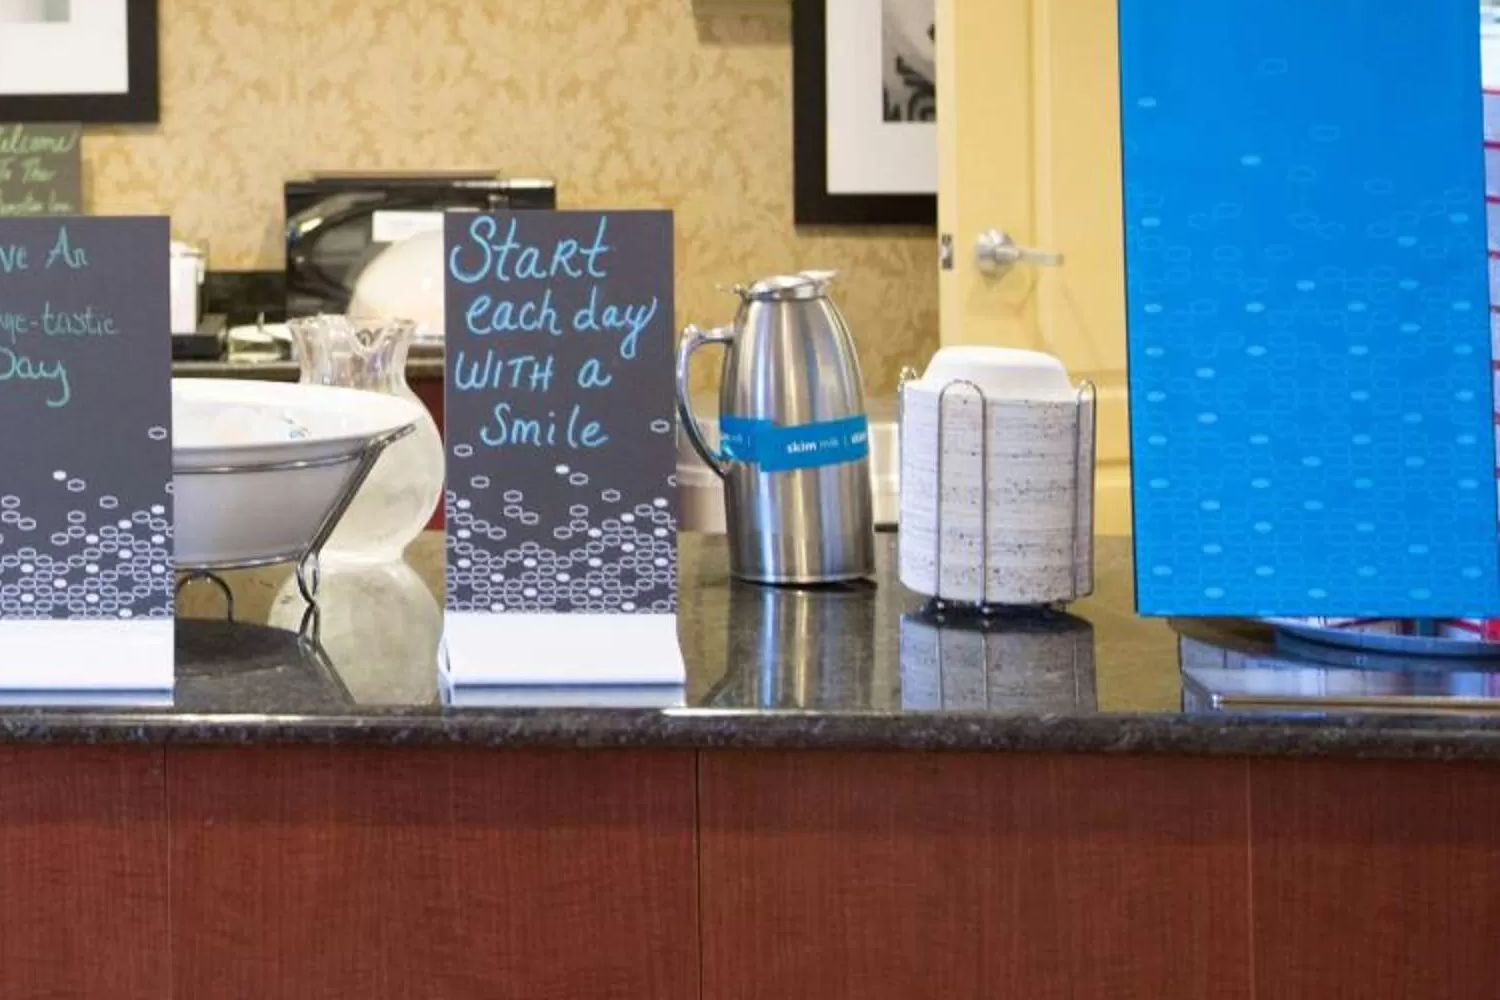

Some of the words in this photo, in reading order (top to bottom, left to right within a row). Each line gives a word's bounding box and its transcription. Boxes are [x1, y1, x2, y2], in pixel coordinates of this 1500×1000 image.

[45, 225, 89, 268] An
[465, 288, 563, 335] each
[573, 285, 658, 360] day
[577, 358, 613, 388] a
[479, 402, 609, 449] Smile
[786, 441, 817, 454] skim
